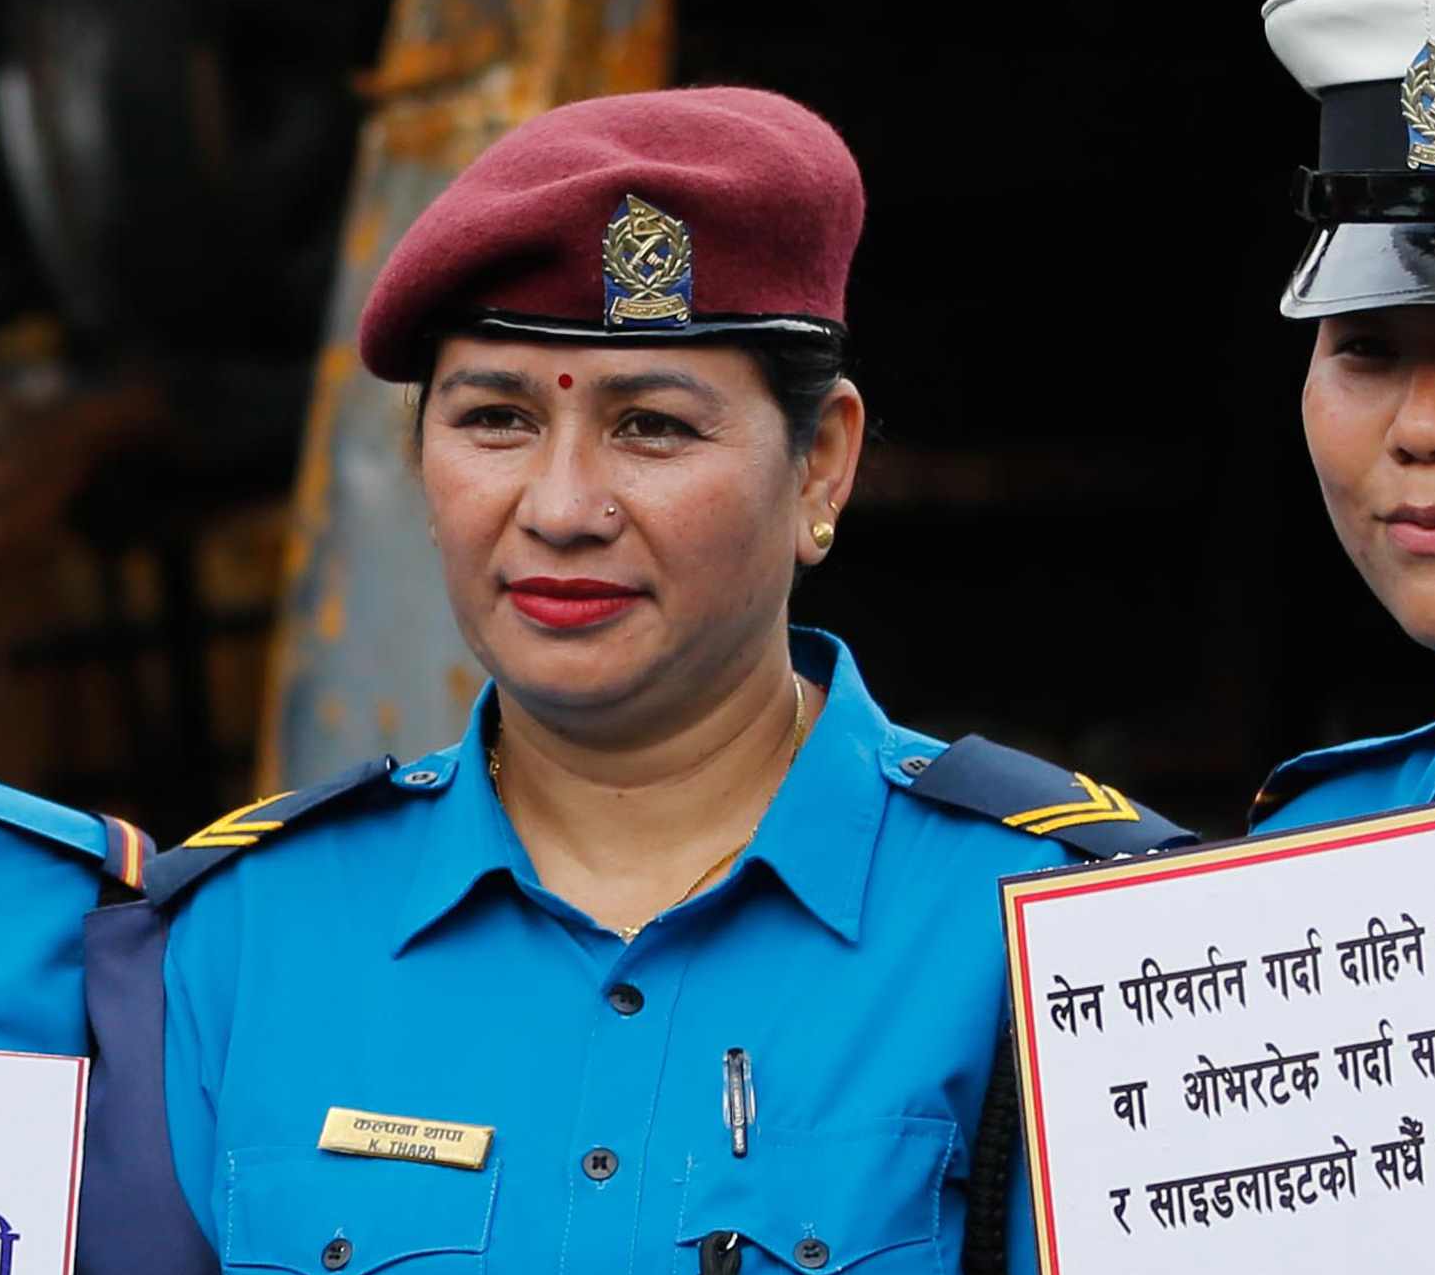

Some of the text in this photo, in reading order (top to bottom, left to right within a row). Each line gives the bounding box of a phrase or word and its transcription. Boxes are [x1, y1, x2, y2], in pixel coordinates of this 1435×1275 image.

[1048, 975, 1103, 1034] लेन
[1119, 946, 1246, 1025] परिवर्तन
[1262, 928, 1323, 1000] गर्दा
[1336, 913, 1426, 986] दाहिने
[1110, 1081, 1148, 1130] वा
[1183, 1043, 1320, 1118] ओभरटेक
[1334, 1020, 1394, 1092] गर्दा
[388, 1141, 437, 1161] THAPA
[1110, 1188, 1131, 1234] र
[1146, 1135, 1358, 1229] साइडलाइटको
